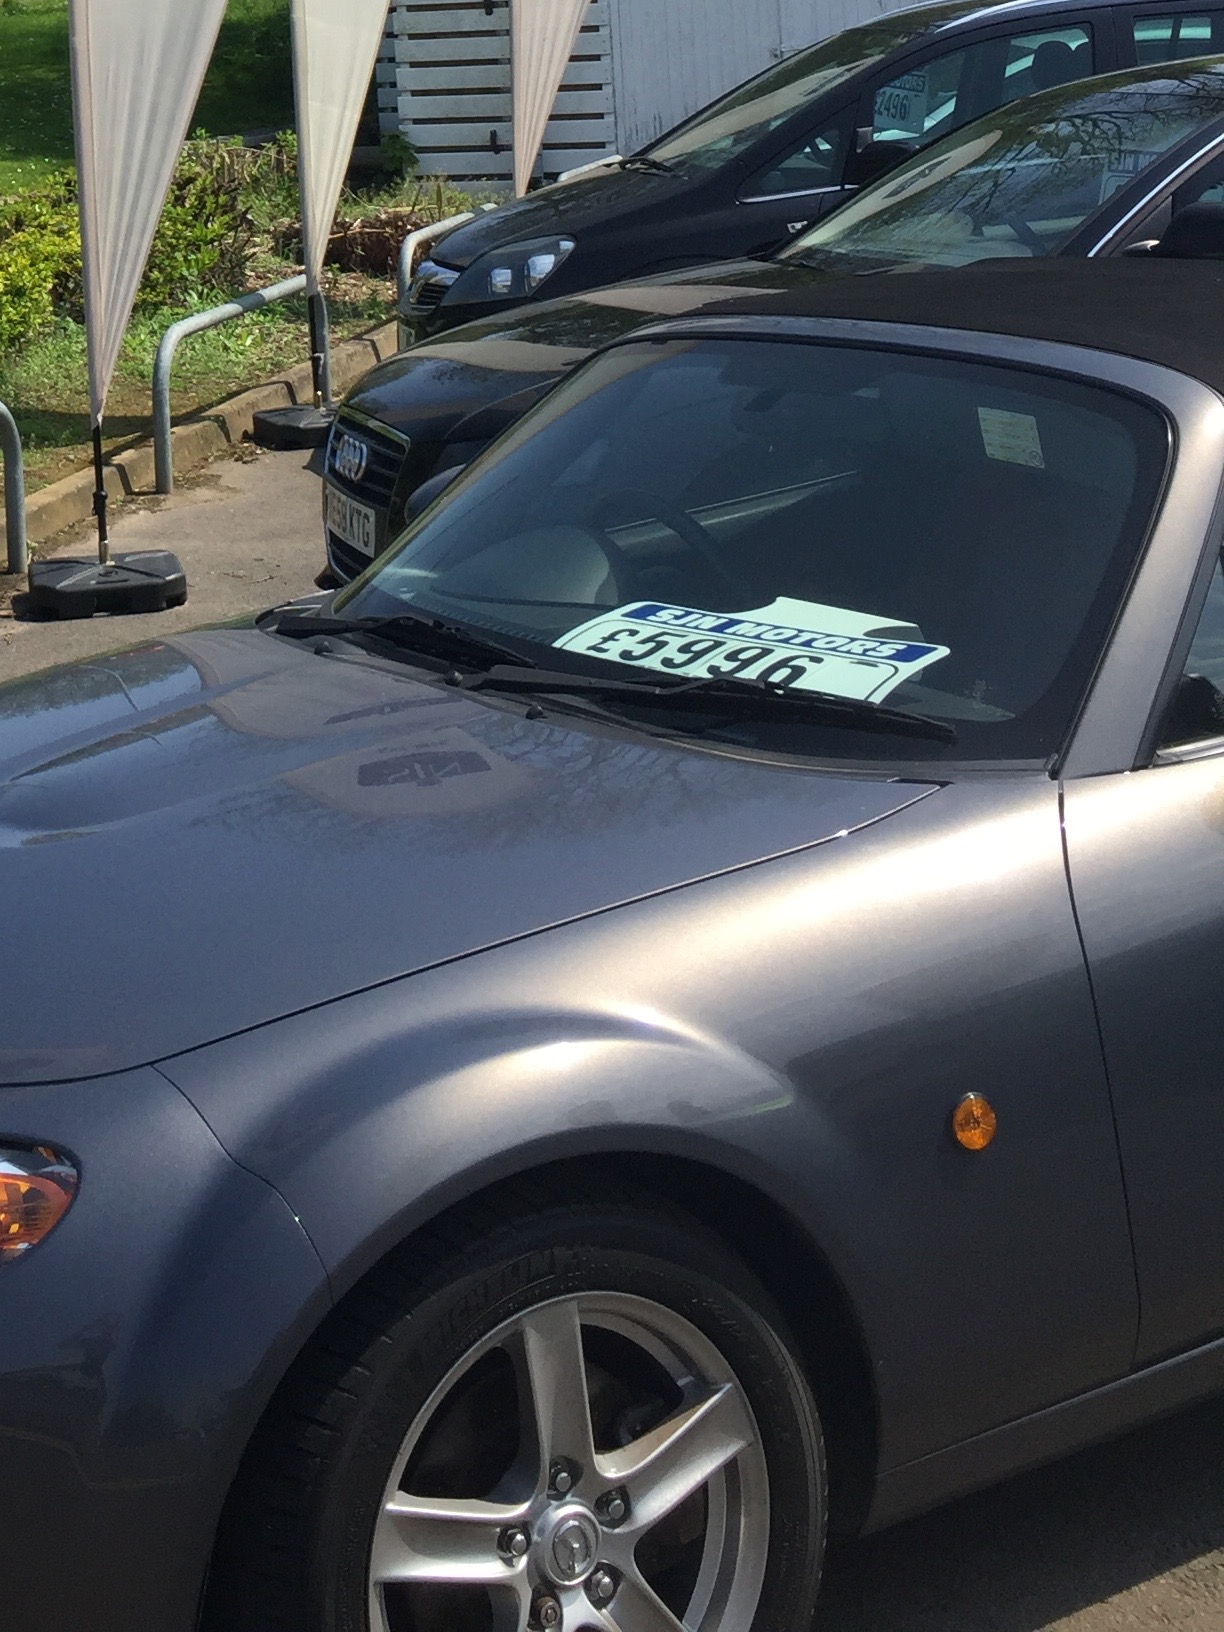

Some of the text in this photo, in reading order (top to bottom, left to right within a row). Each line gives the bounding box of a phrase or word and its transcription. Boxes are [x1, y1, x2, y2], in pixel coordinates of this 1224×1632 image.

[585, 629, 825, 690] £5996
[646, 608, 908, 658] SJN MOTORS
